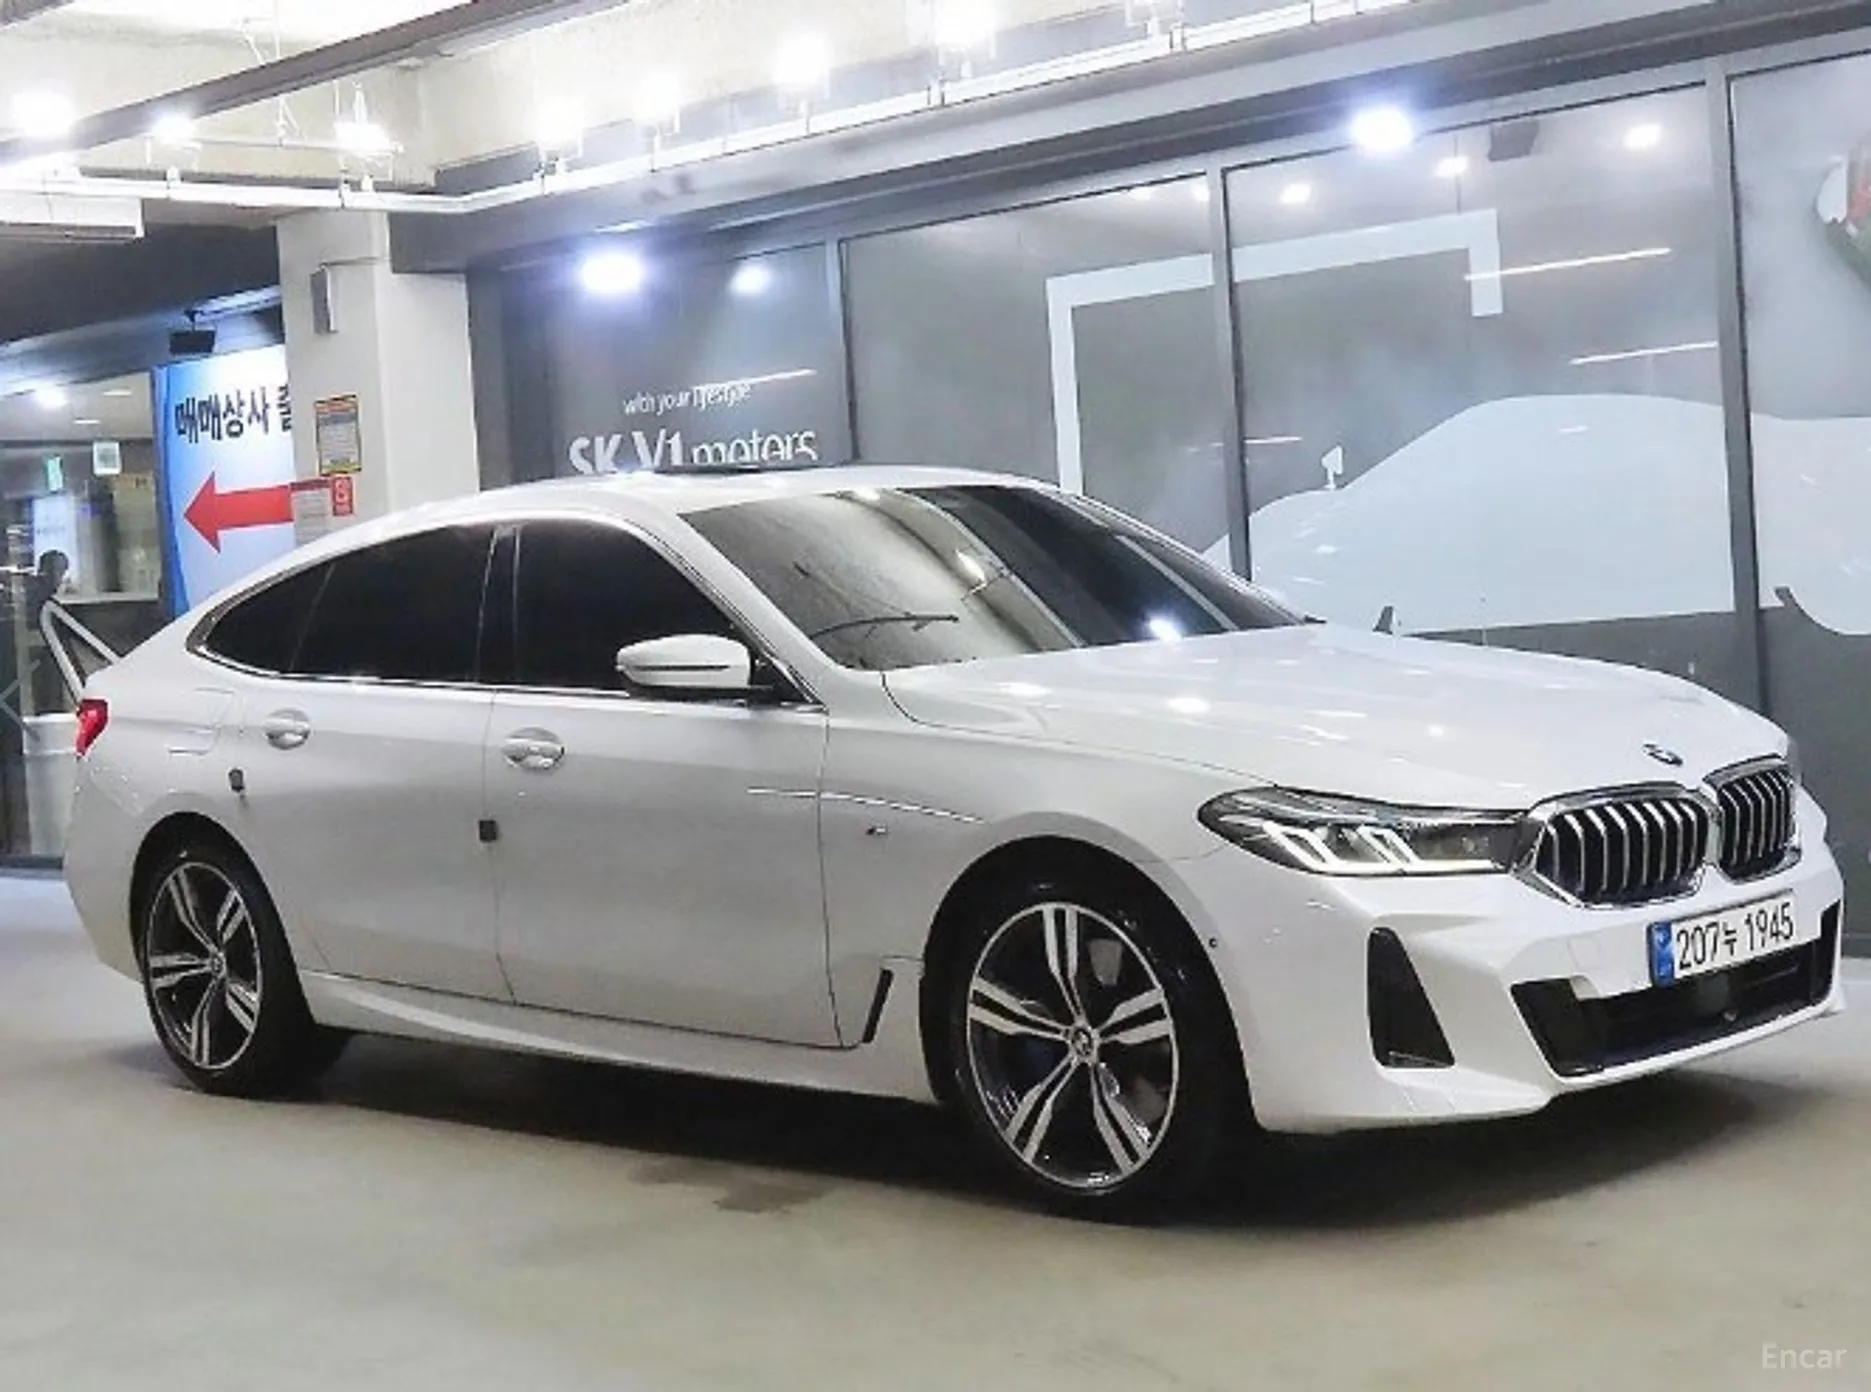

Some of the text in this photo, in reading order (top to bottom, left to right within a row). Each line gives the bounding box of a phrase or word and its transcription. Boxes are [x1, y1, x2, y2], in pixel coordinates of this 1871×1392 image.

[174, 385, 270, 444] 매매상사
[569, 433, 623, 475] SK
[692, 428, 819, 466] motors
[1744, 901, 1794, 952] 1945
